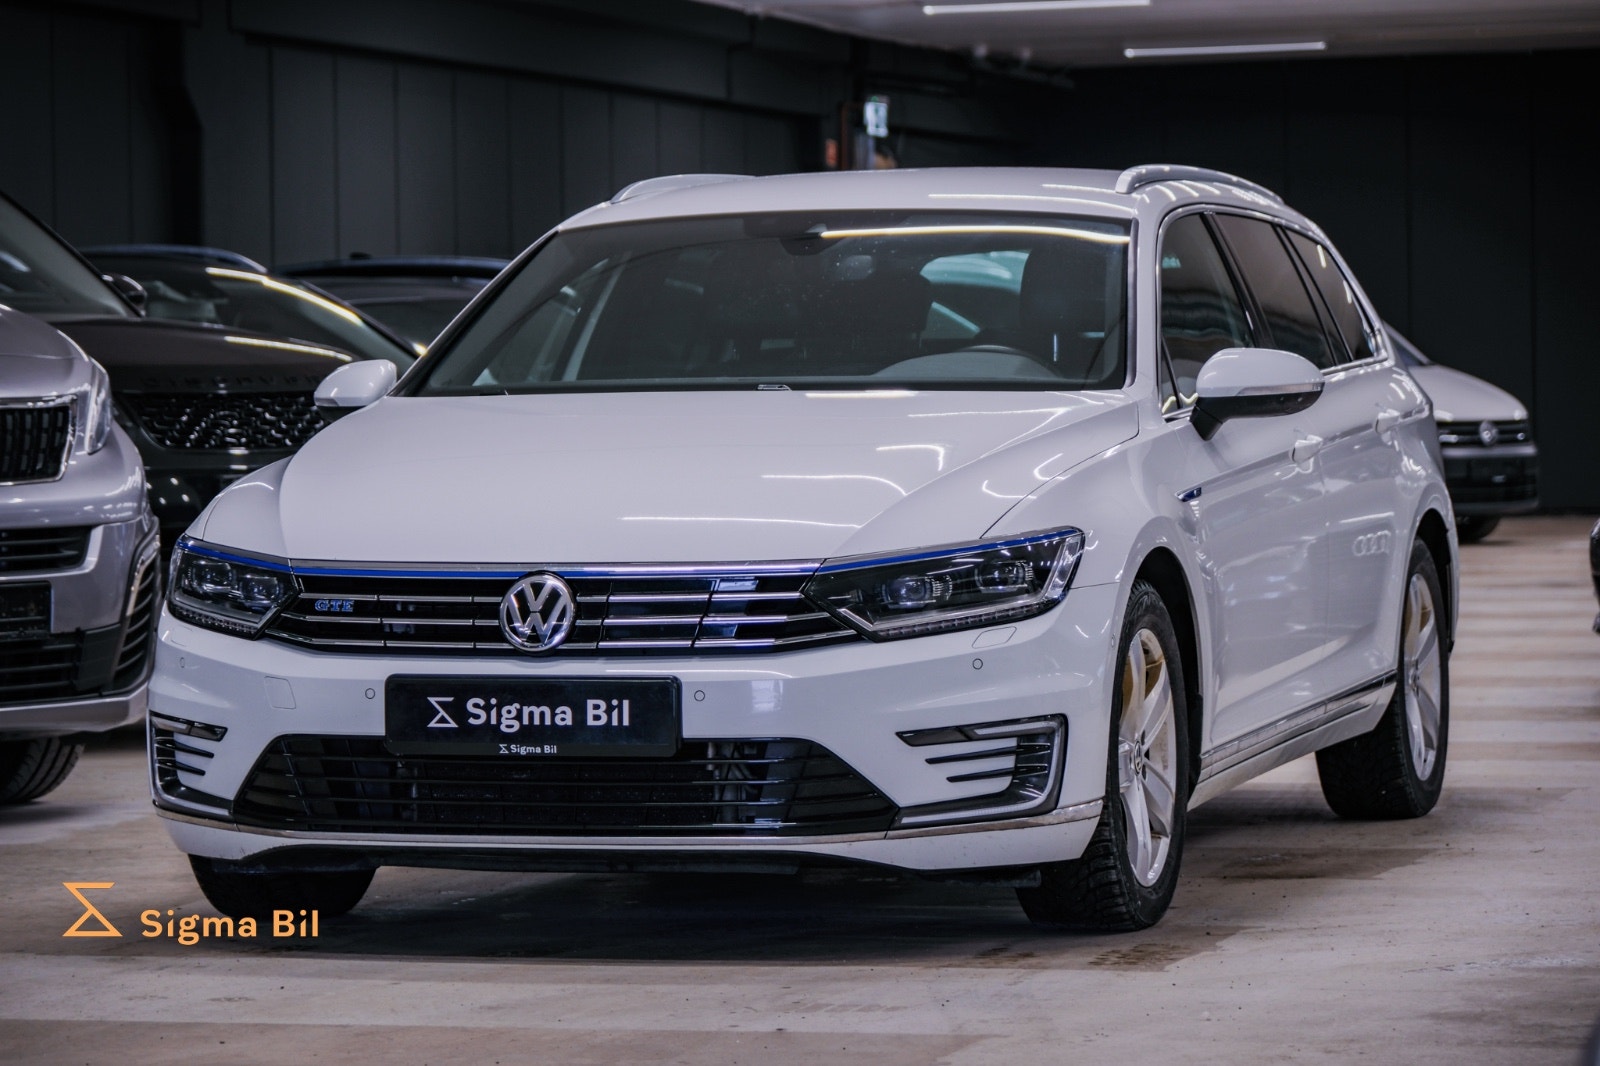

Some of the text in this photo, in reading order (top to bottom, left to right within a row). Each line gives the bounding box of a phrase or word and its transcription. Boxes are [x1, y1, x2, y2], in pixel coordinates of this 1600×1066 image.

[315, 599, 354, 612] GTE
[504, 578, 571, 647] VW
[466, 697, 629, 733] Sigma Bil
[510, 744, 557, 755] Sigma Bil
